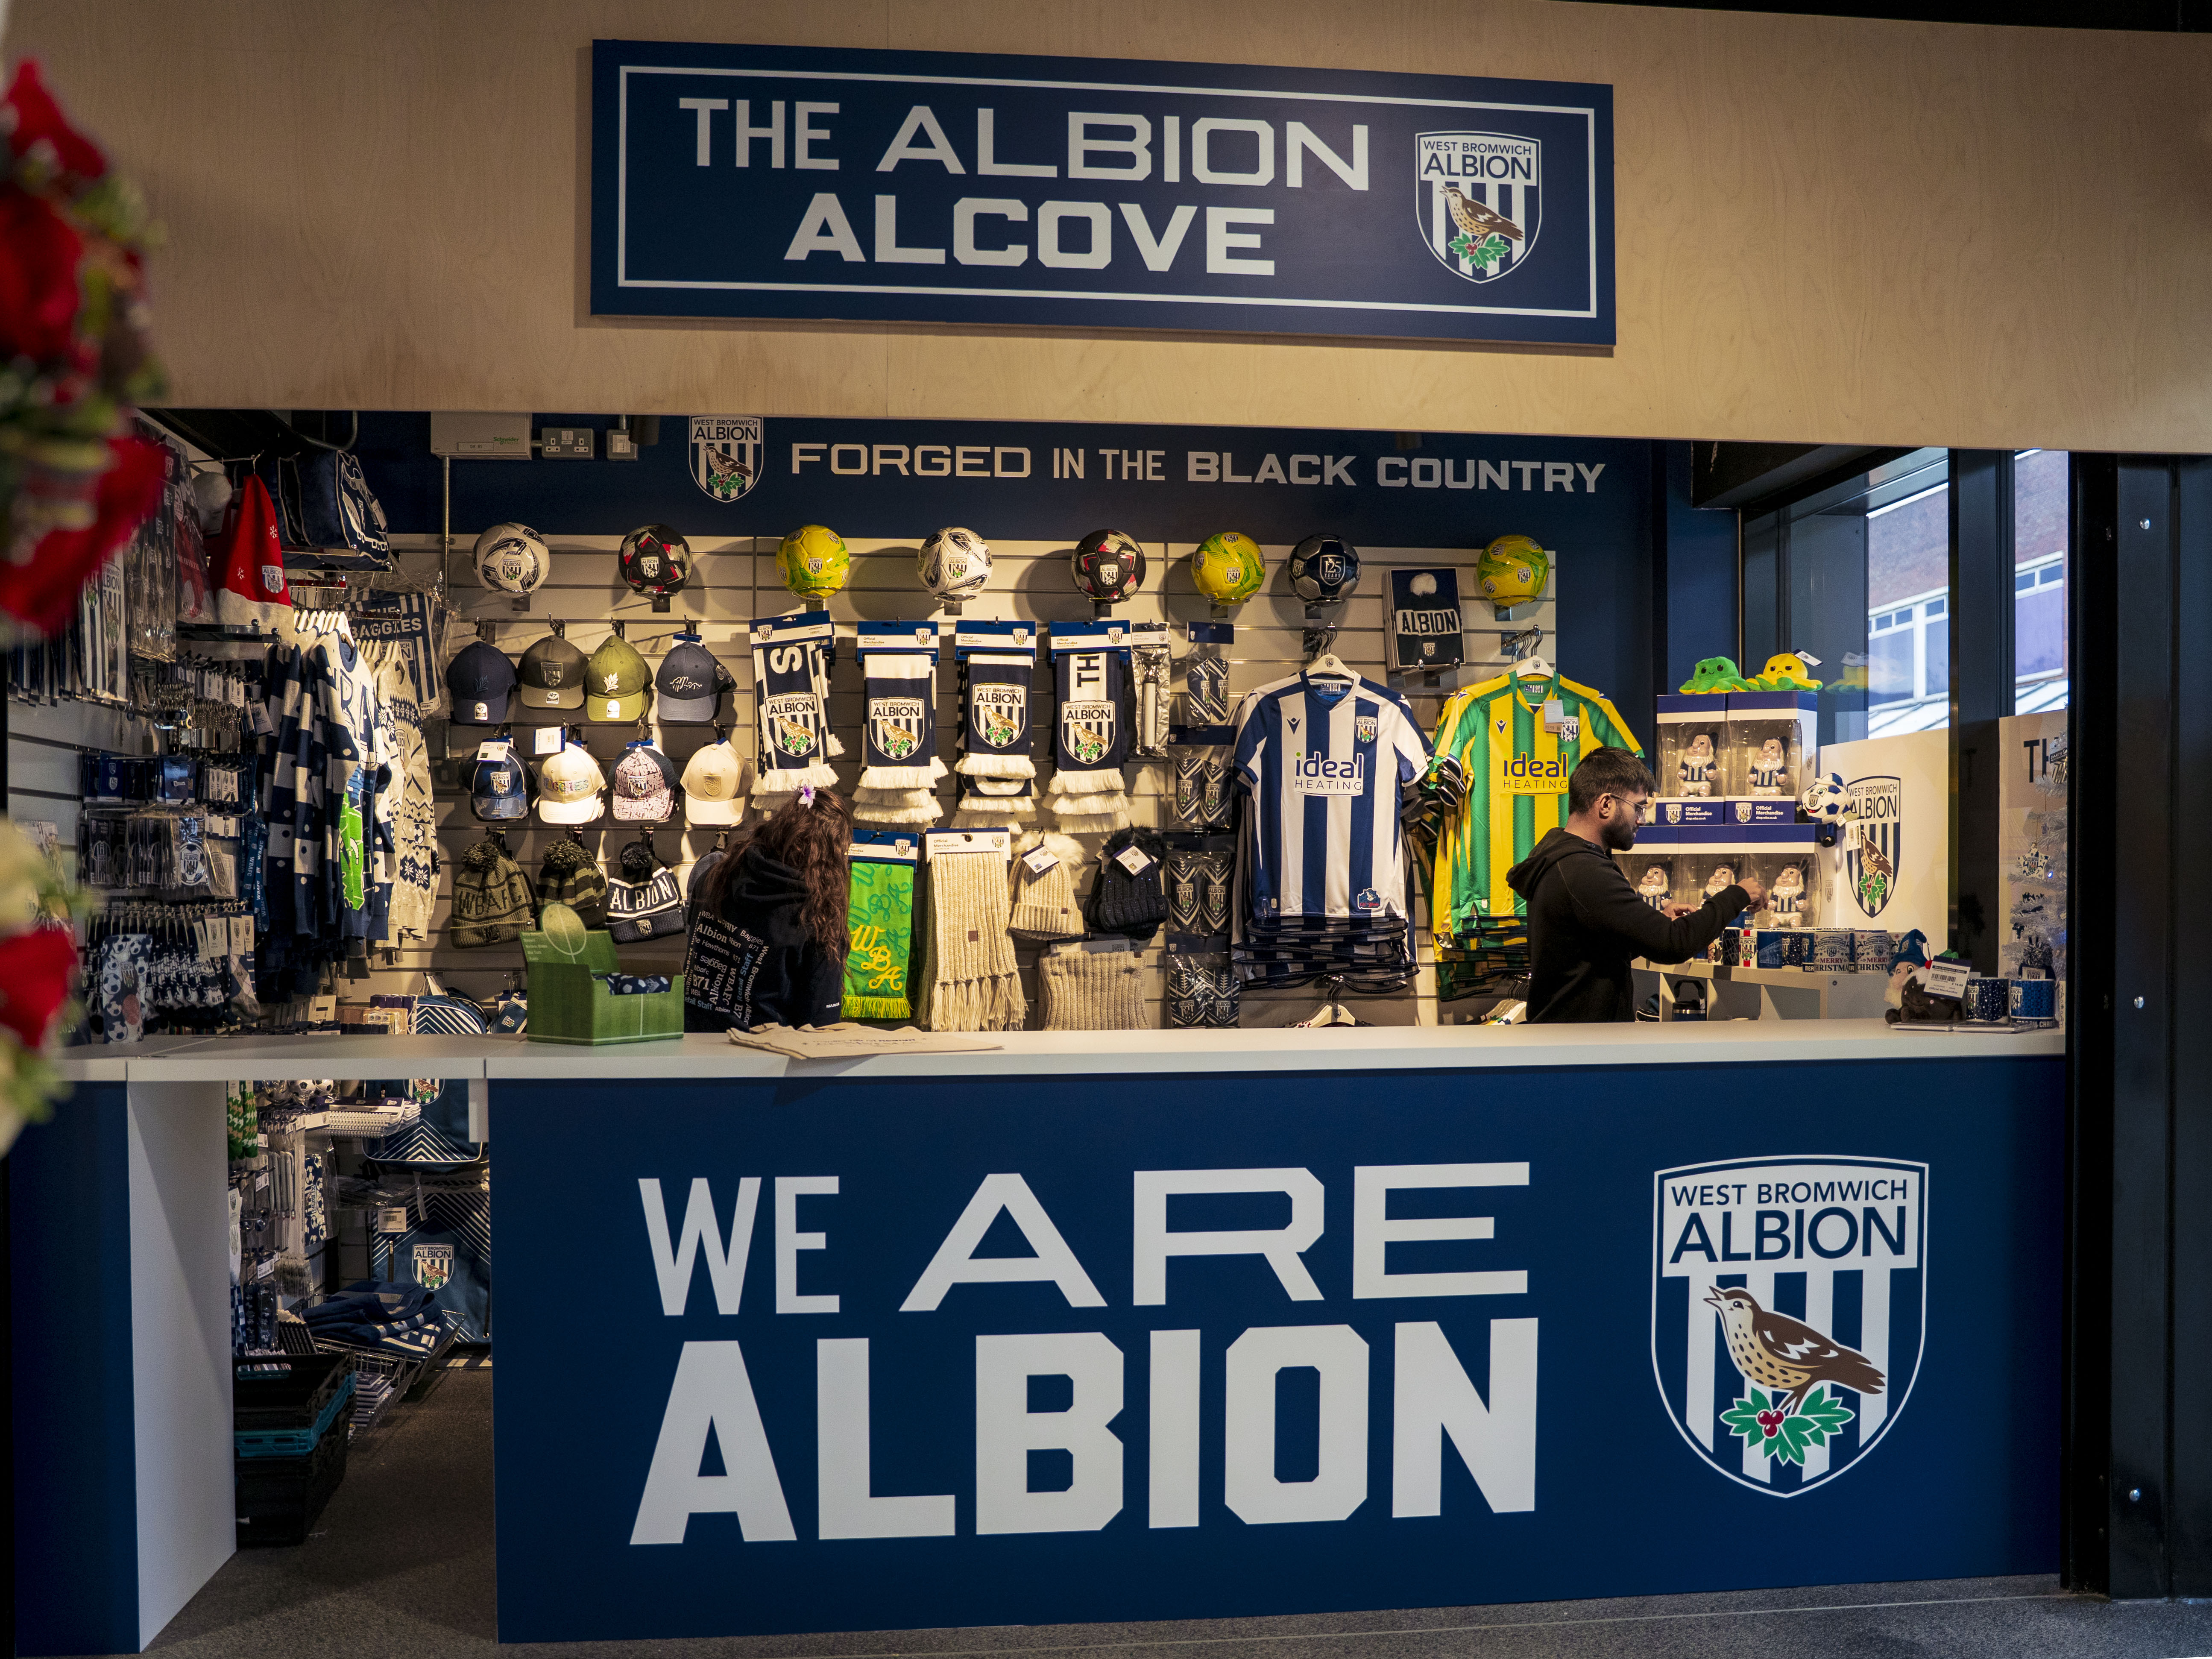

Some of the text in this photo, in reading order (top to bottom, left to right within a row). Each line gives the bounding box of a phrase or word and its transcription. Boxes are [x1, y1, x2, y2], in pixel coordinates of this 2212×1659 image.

[680, 98, 1369, 191] THE ALBION
[1423, 141, 1532, 155] WEST BROMWICH
[1423, 154, 1532, 180] ALBION
[784, 193, 1275, 276] ALCOVE
[493, 437, 519, 445] Schneider
[694, 426, 757, 441] ALBION
[792, 443, 1606, 493] FORGED IN THE BLACK COUNTRY
[1325, 560, 1342, 573] 125
[103, 575, 120, 591] LBION
[351, 618, 422, 639] BAGGIES
[1402, 610, 1458, 633] ALBION
[769, 701, 815, 715] ALBION
[785, 695, 814, 703] BROMWICH
[976, 693, 1022, 704] ALBION
[873, 707, 920, 717] ALBION
[1065, 709, 1111, 720] ALBION
[1296, 752, 1362, 778] ideal
[1503, 753, 1567, 777] ideal
[1295, 780, 1362, 790] HEATING
[1503, 780, 1568, 789] HEATING
[1849, 783, 1897, 797] WEST BROMWICH
[1850, 795, 1897, 820] ALBION
[247, 856, 255, 876] WBAFC
[459, 882, 523, 916] WBAFC
[610, 875, 674, 911] ALBION
[701, 910, 714, 921] WBA
[697, 923, 727, 944] Albion
[718, 919, 738, 933] Albio
[740, 929, 764, 945] Baggies
[702, 940, 730, 956] Hawthorns
[749, 943, 759, 952] B71
[700, 955, 727, 973] Baggies
[740, 953, 753, 976] Staff
[850, 924, 903, 991] WBA
[693, 974, 710, 991] B71
[744, 945, 769, 1002] West Bromwich
[691, 988, 701, 997] WBA
[709, 973, 724, 1005] Albion
[722, 967, 737, 1005] WBAFC
[697, 1000, 713, 1011] Staff
[1671, 1179, 1907, 1207] WEST BROMWICH
[638, 1162, 1529, 1316] WE ARE
[1669, 1206, 1907, 1264] ALBION
[630, 1318, 1538, 1545] ALBION
